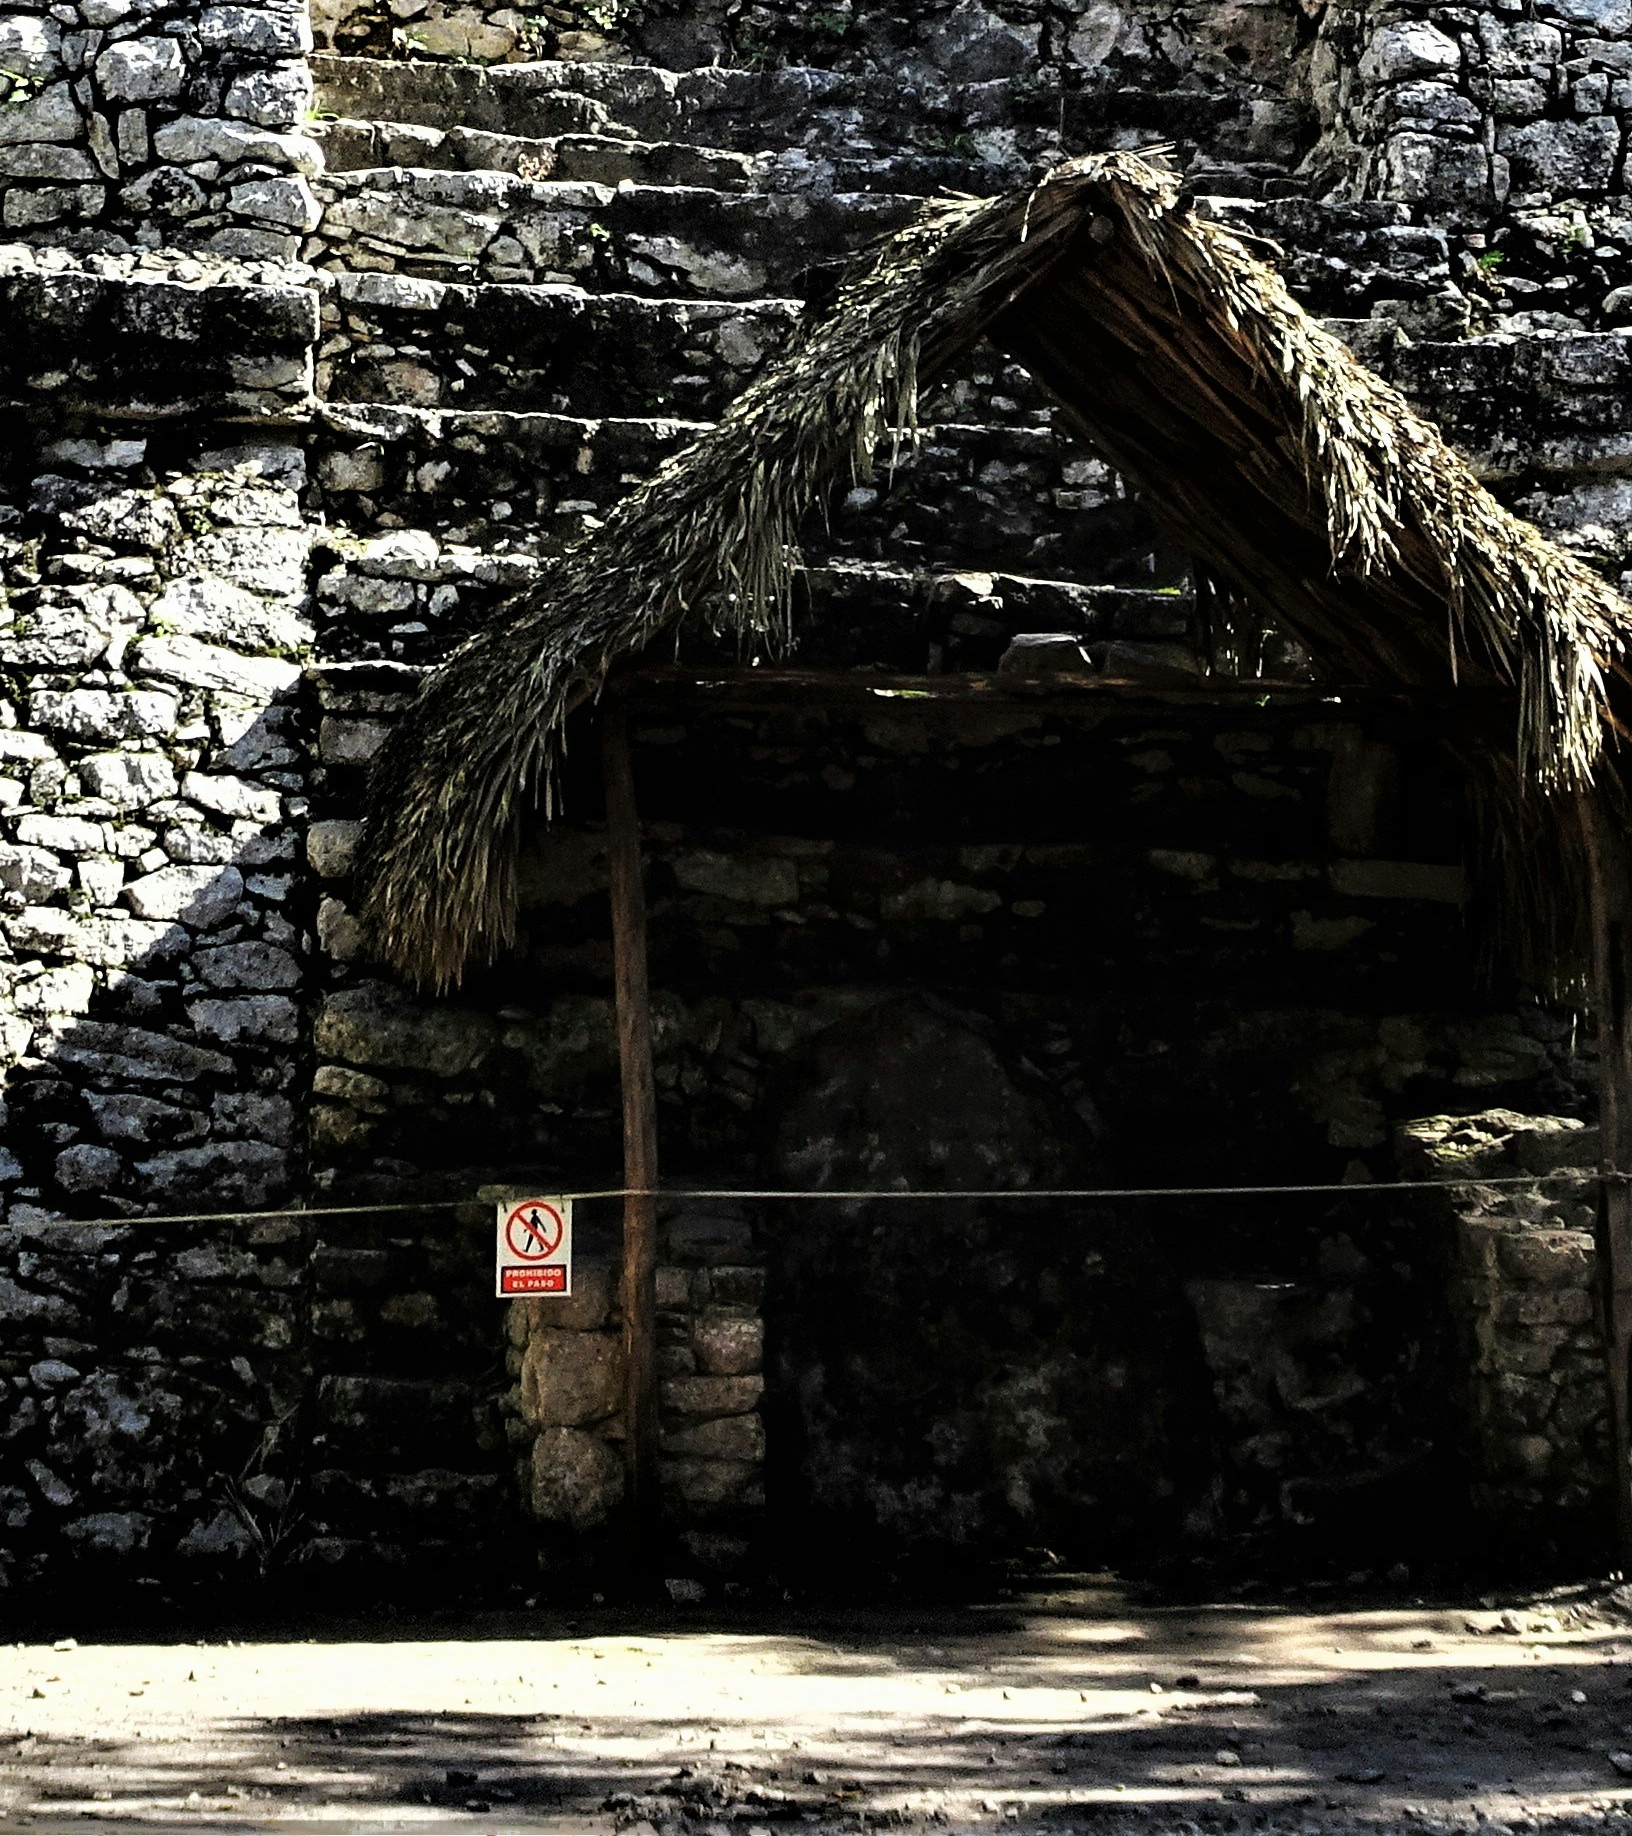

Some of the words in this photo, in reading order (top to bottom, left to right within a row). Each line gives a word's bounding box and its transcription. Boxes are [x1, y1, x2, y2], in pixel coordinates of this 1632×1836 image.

[505, 1268, 561, 1277] PROHIBIDO
[512, 1280, 525, 1288] EL
[527, 1279, 554, 1288] PASO
